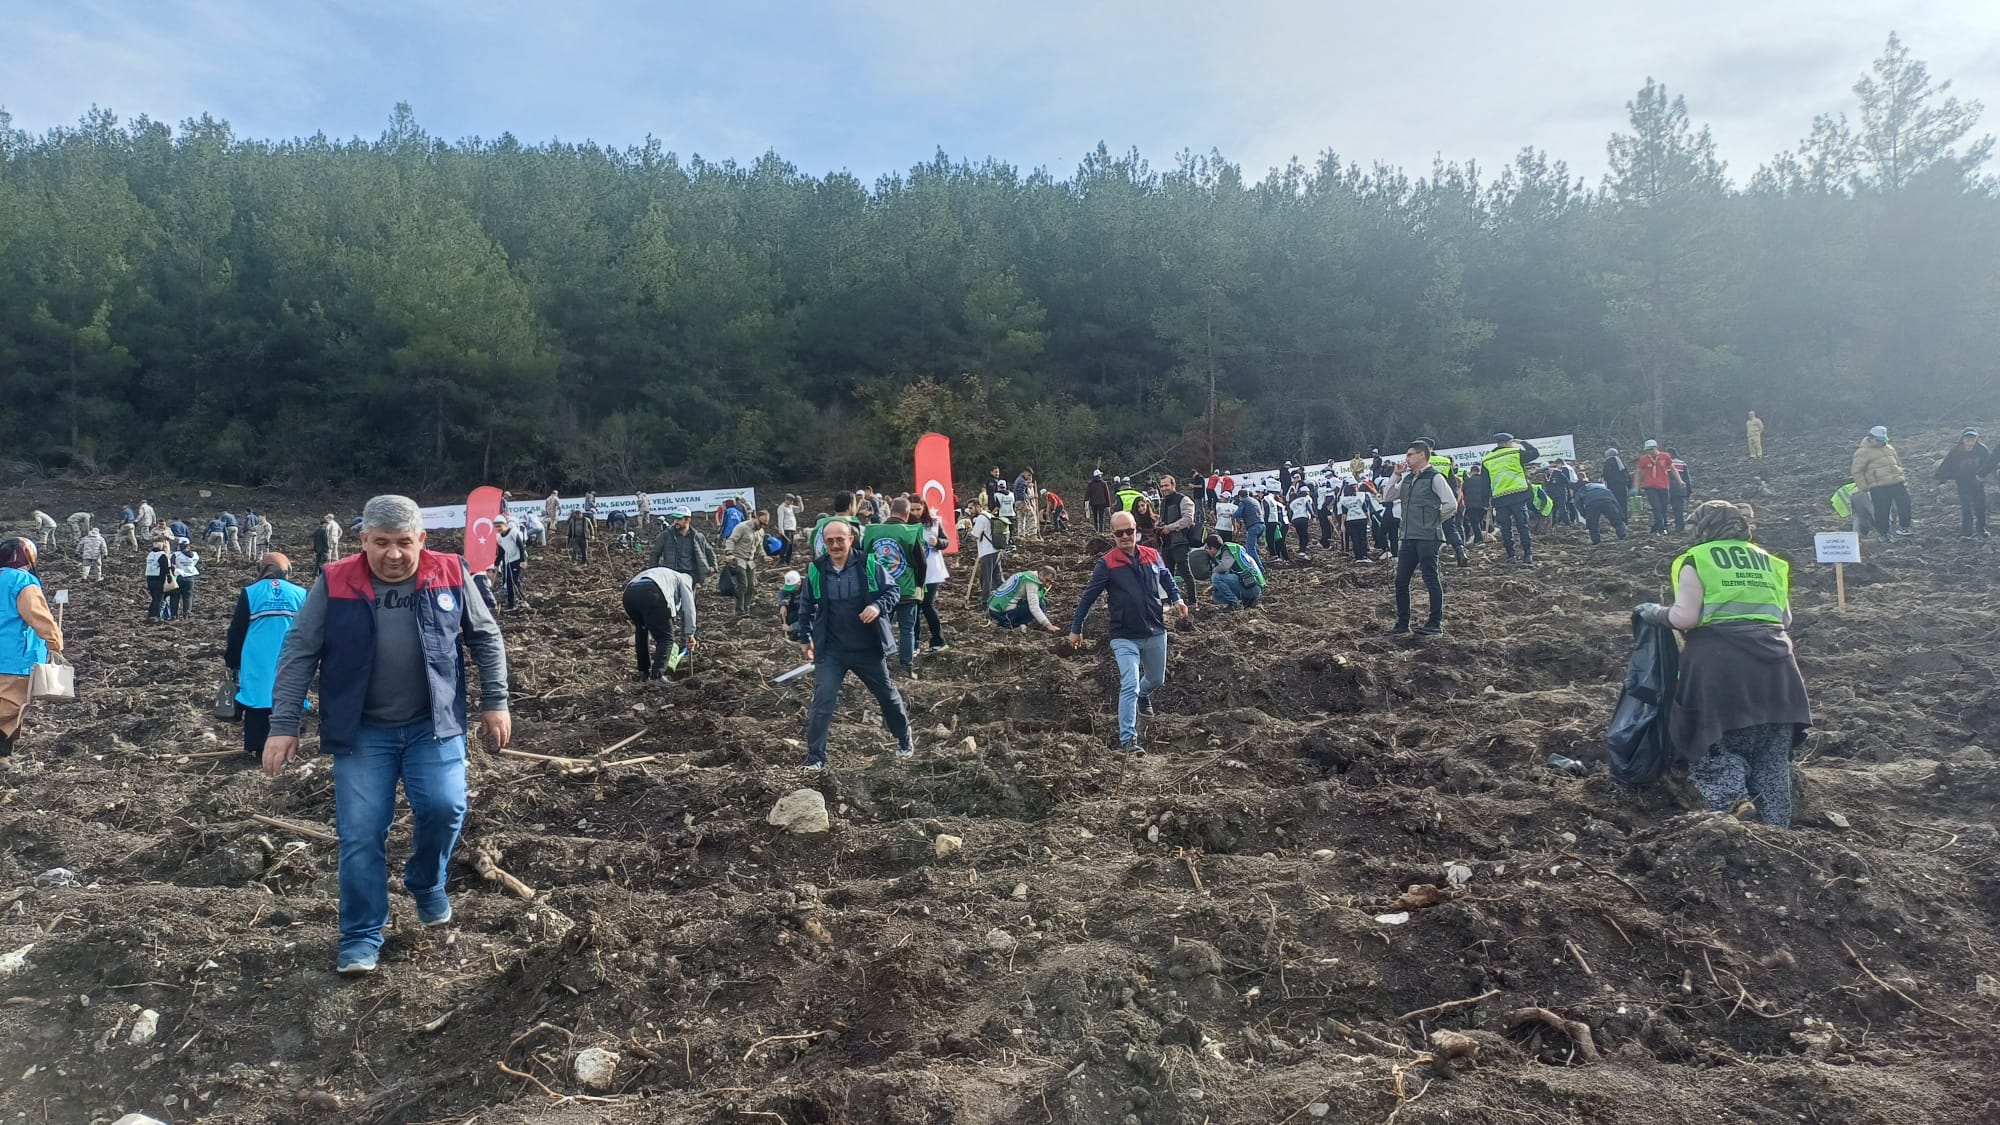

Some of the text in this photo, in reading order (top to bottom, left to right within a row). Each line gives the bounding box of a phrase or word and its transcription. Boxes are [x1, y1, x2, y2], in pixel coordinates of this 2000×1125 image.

[1453, 451, 1477, 460] YEŞİL
[610, 500, 650, 508] SEVDA
[652, 497, 673, 505] YEŞİL
[1709, 545, 1772, 572] OGM
[384, 589, 417, 612] Coop
